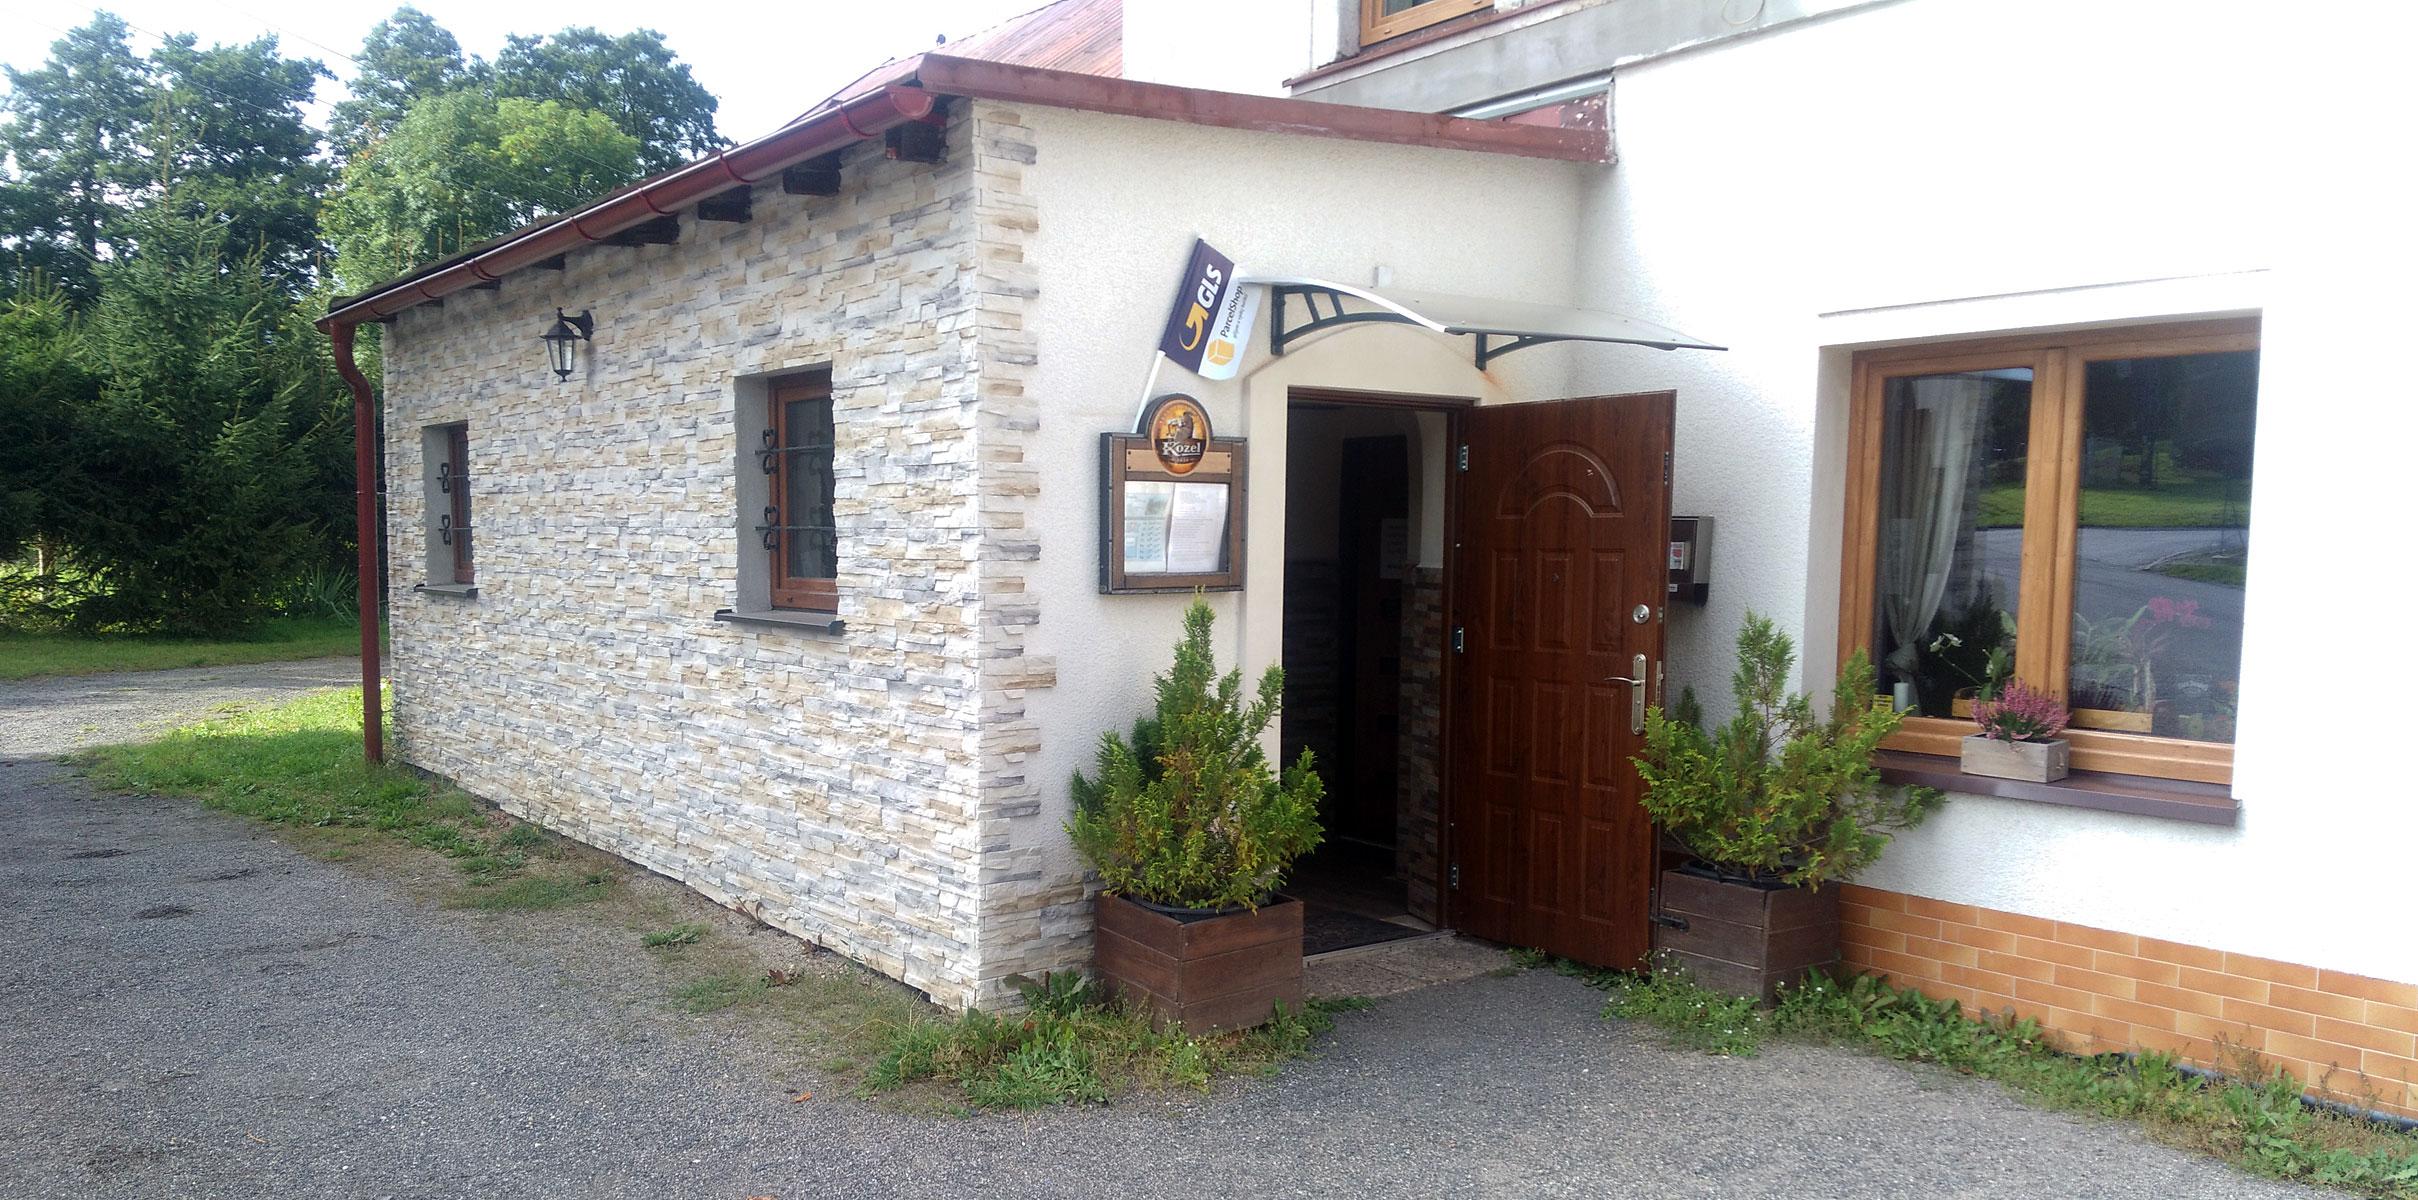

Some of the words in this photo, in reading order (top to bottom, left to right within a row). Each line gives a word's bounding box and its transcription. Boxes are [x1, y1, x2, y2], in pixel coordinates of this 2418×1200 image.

[1197, 264, 1222, 308] GLS
[1220, 286, 1243, 338] ParcelShop
[1162, 441, 1201, 457] Kozel
